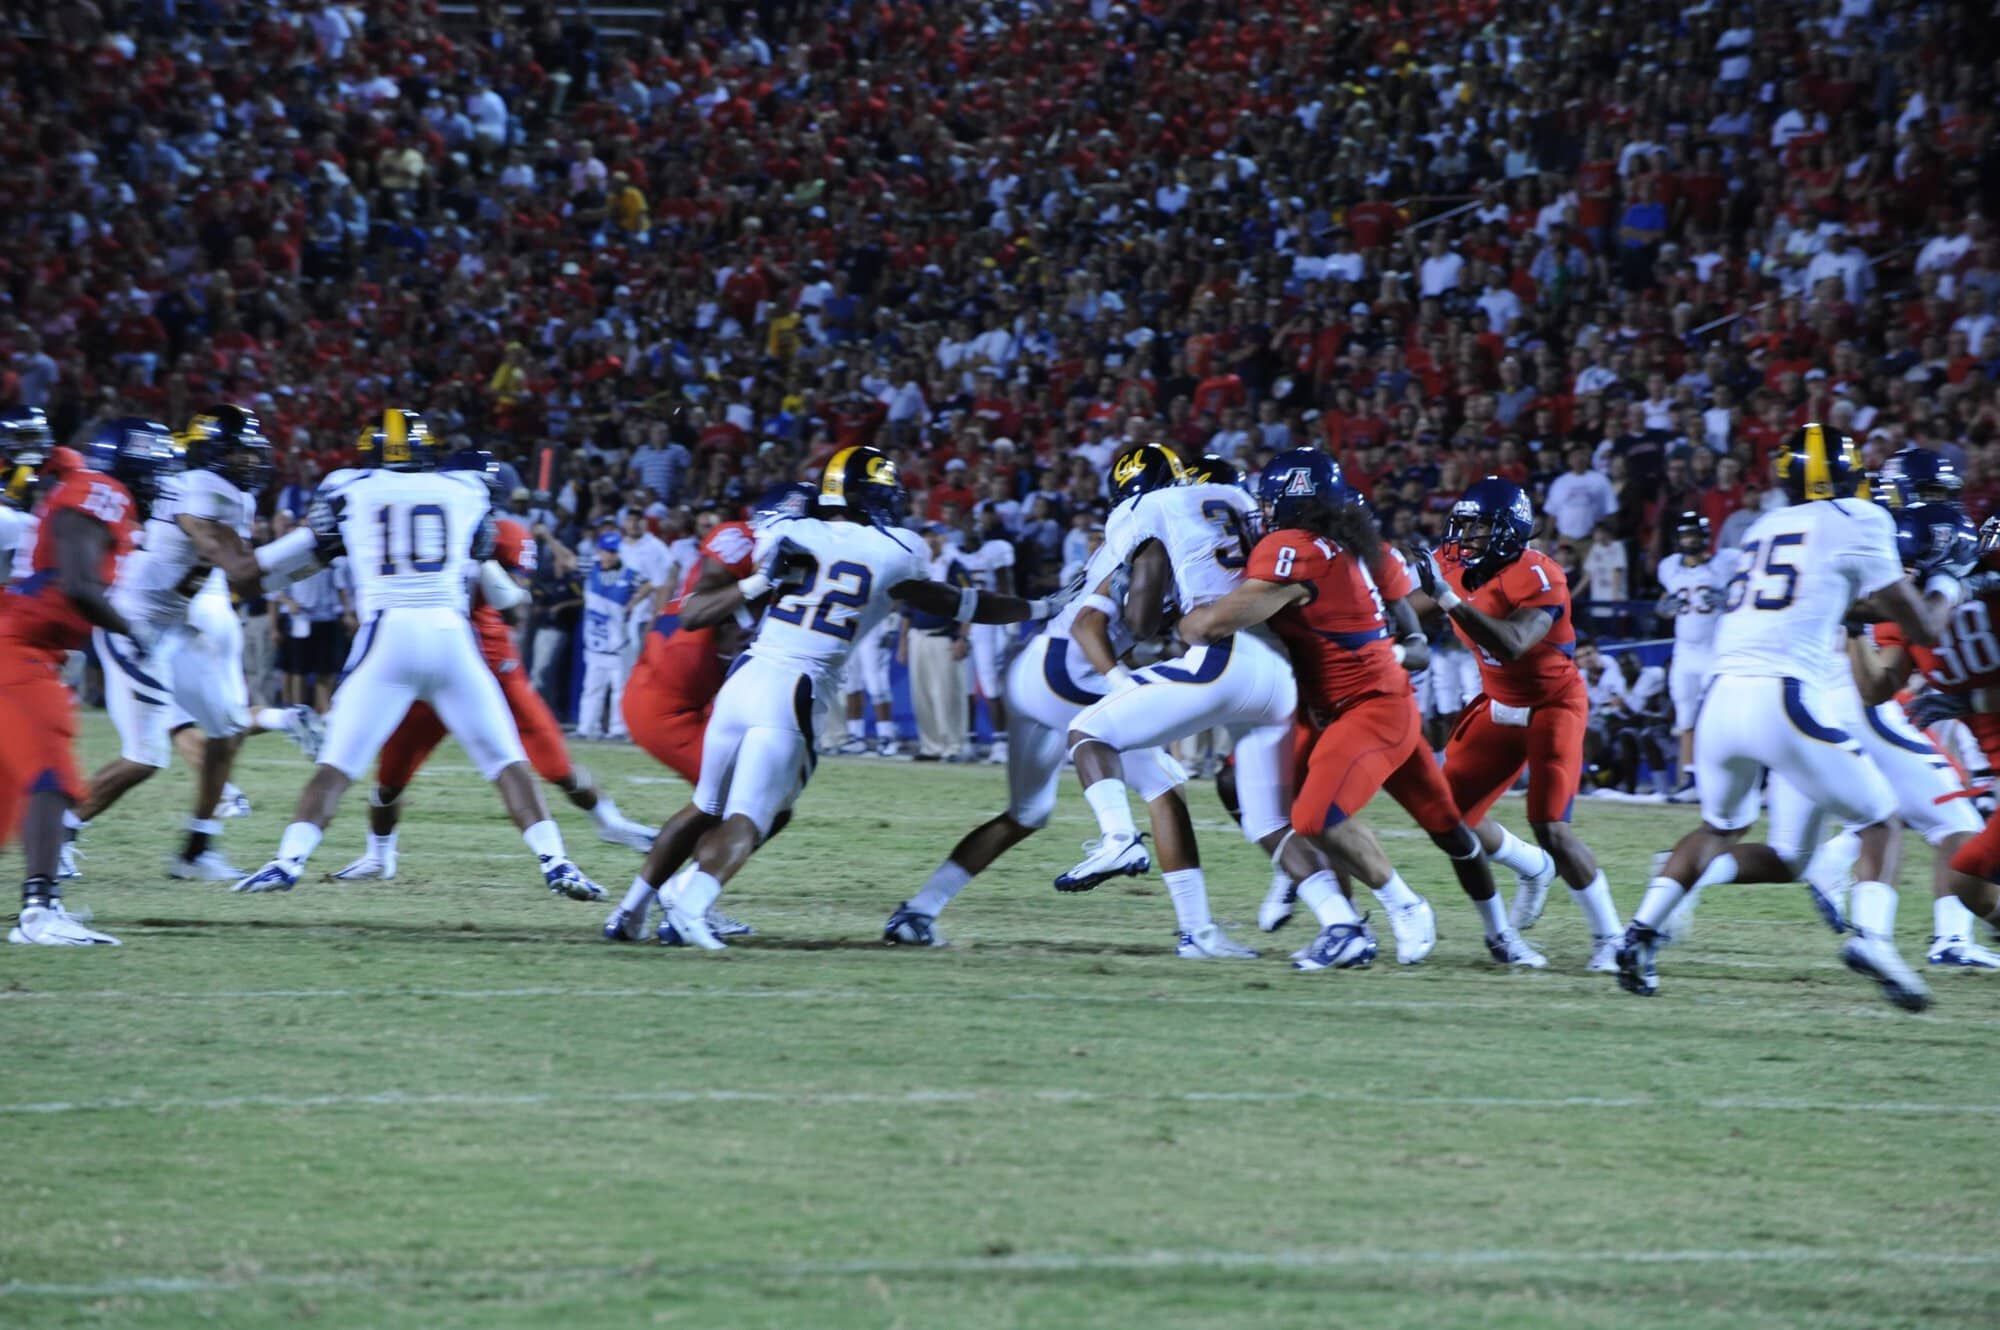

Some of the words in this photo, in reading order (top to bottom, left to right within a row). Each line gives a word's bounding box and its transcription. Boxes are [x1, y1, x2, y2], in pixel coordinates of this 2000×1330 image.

[1113, 449, 1147, 488] Cal
[1285, 467, 1317, 496] A
[376, 504, 447, 576] 10
[1274, 546, 1297, 577] 8
[1530, 565, 1552, 592] 1
[768, 552, 874, 642] 22
